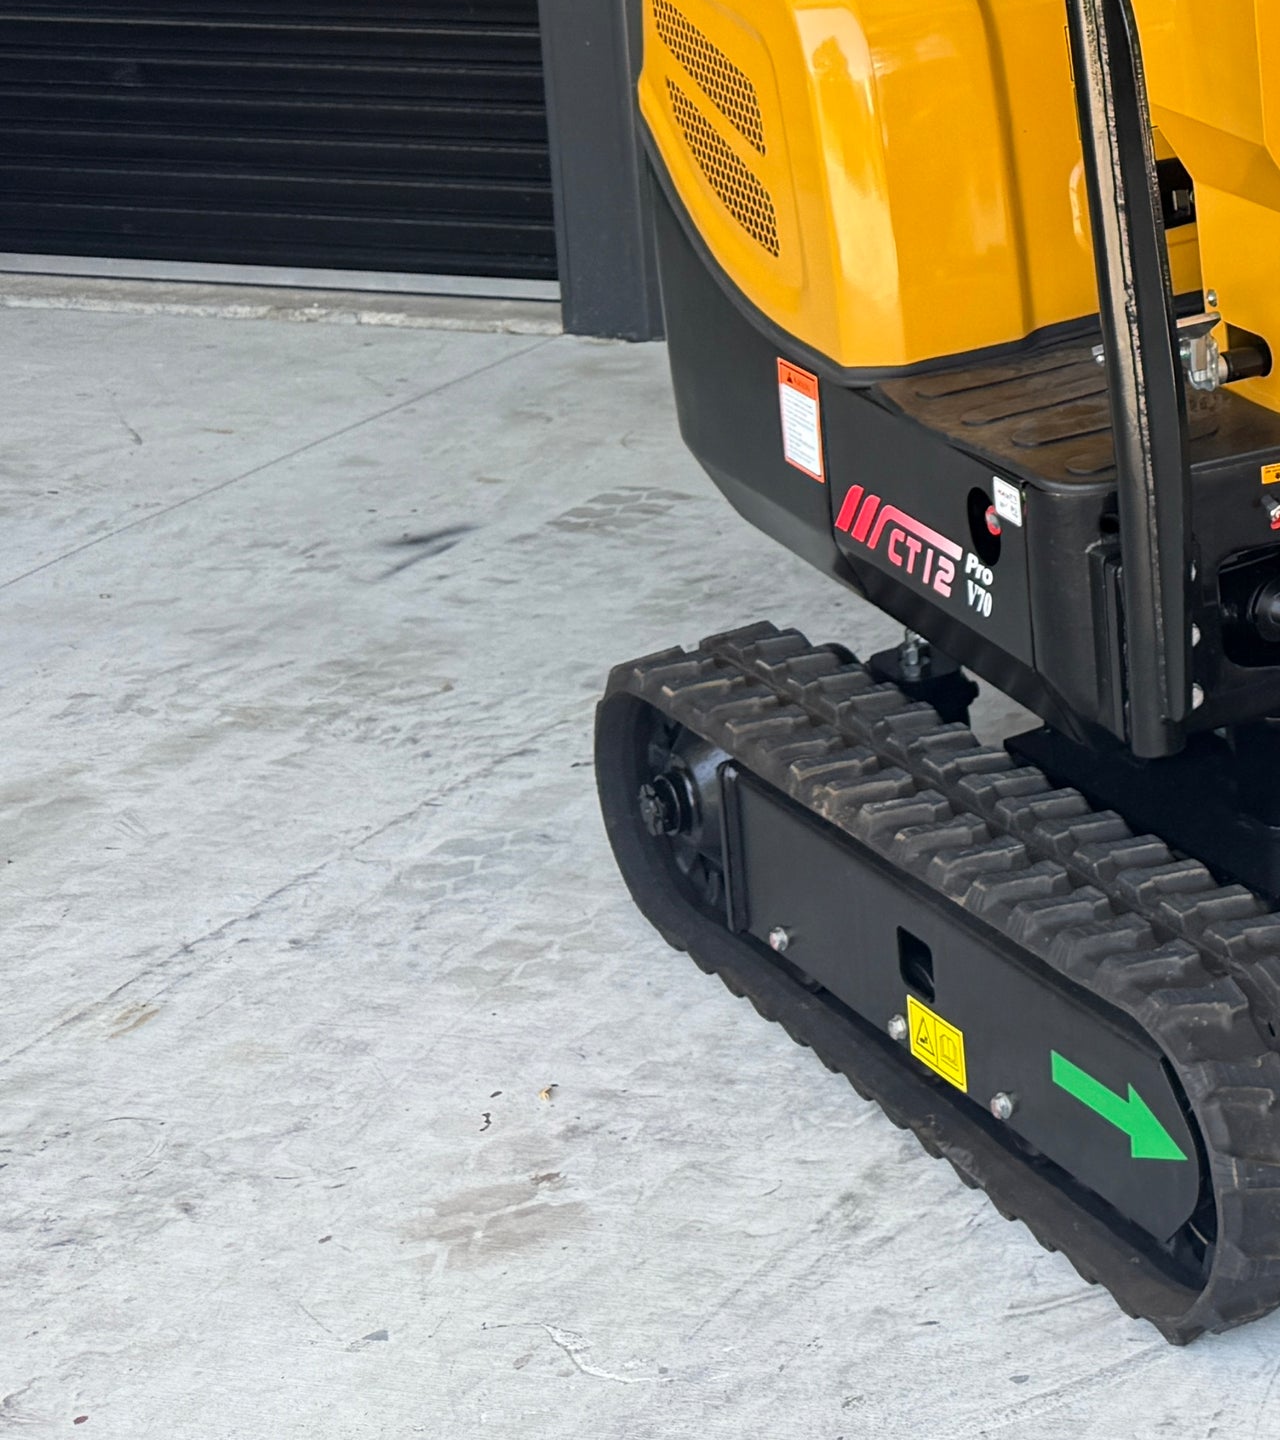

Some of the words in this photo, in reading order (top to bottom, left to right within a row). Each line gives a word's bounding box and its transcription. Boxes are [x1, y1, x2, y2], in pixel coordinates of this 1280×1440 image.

[888, 528, 955, 598] CT12
[965, 553, 994, 586] Pro
[967, 580, 993, 618] V70
